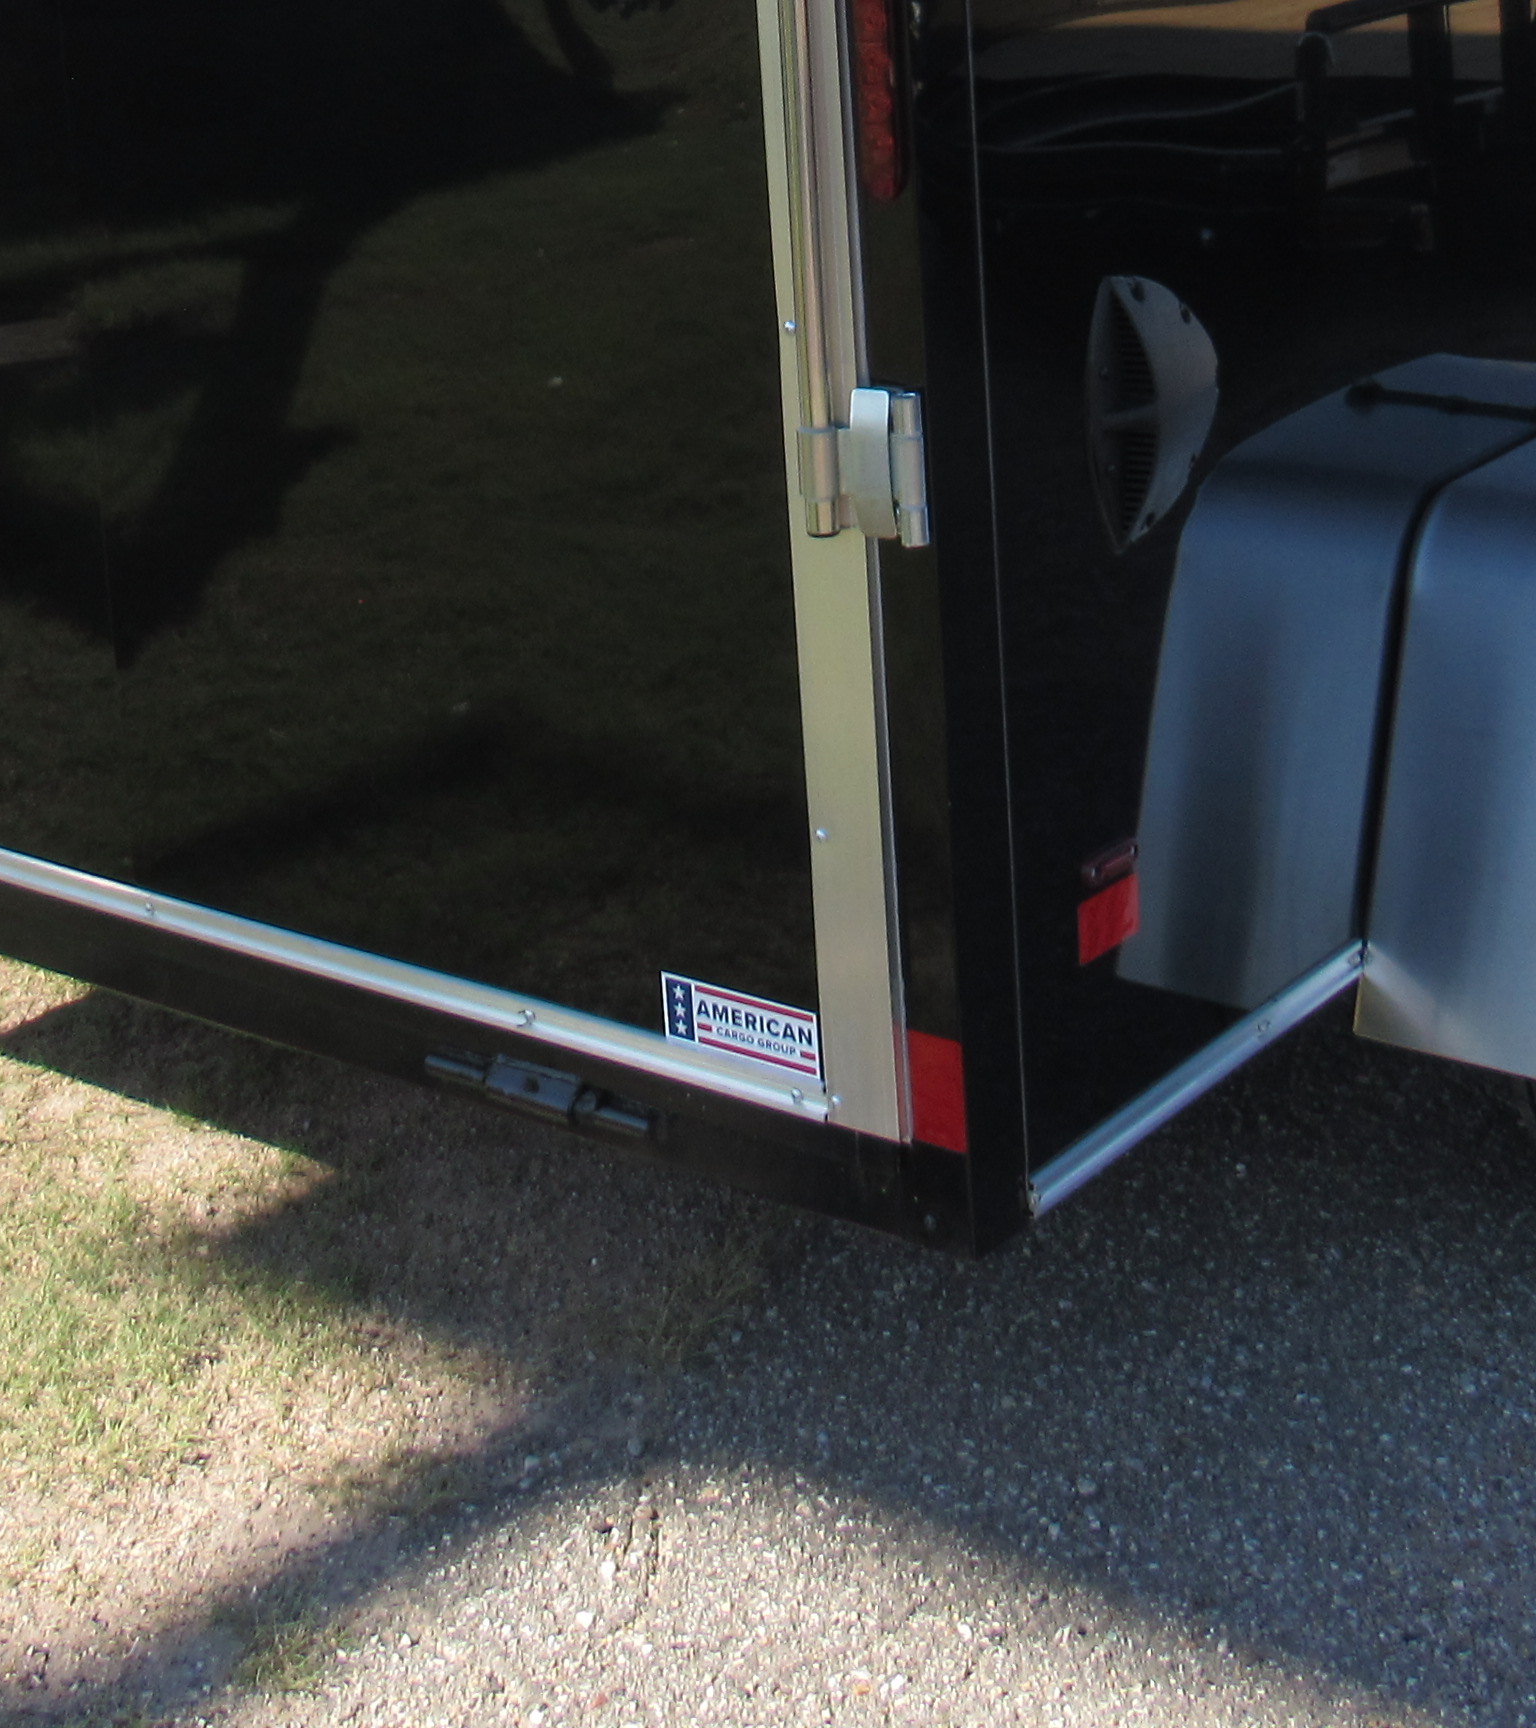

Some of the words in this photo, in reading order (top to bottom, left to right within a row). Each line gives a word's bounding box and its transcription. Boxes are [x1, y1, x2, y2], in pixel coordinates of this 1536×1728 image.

[696, 1000, 813, 1046] AMERICAN
[716, 1026, 754, 1045] CARGO
[757, 1039, 796, 1056] GROUP
